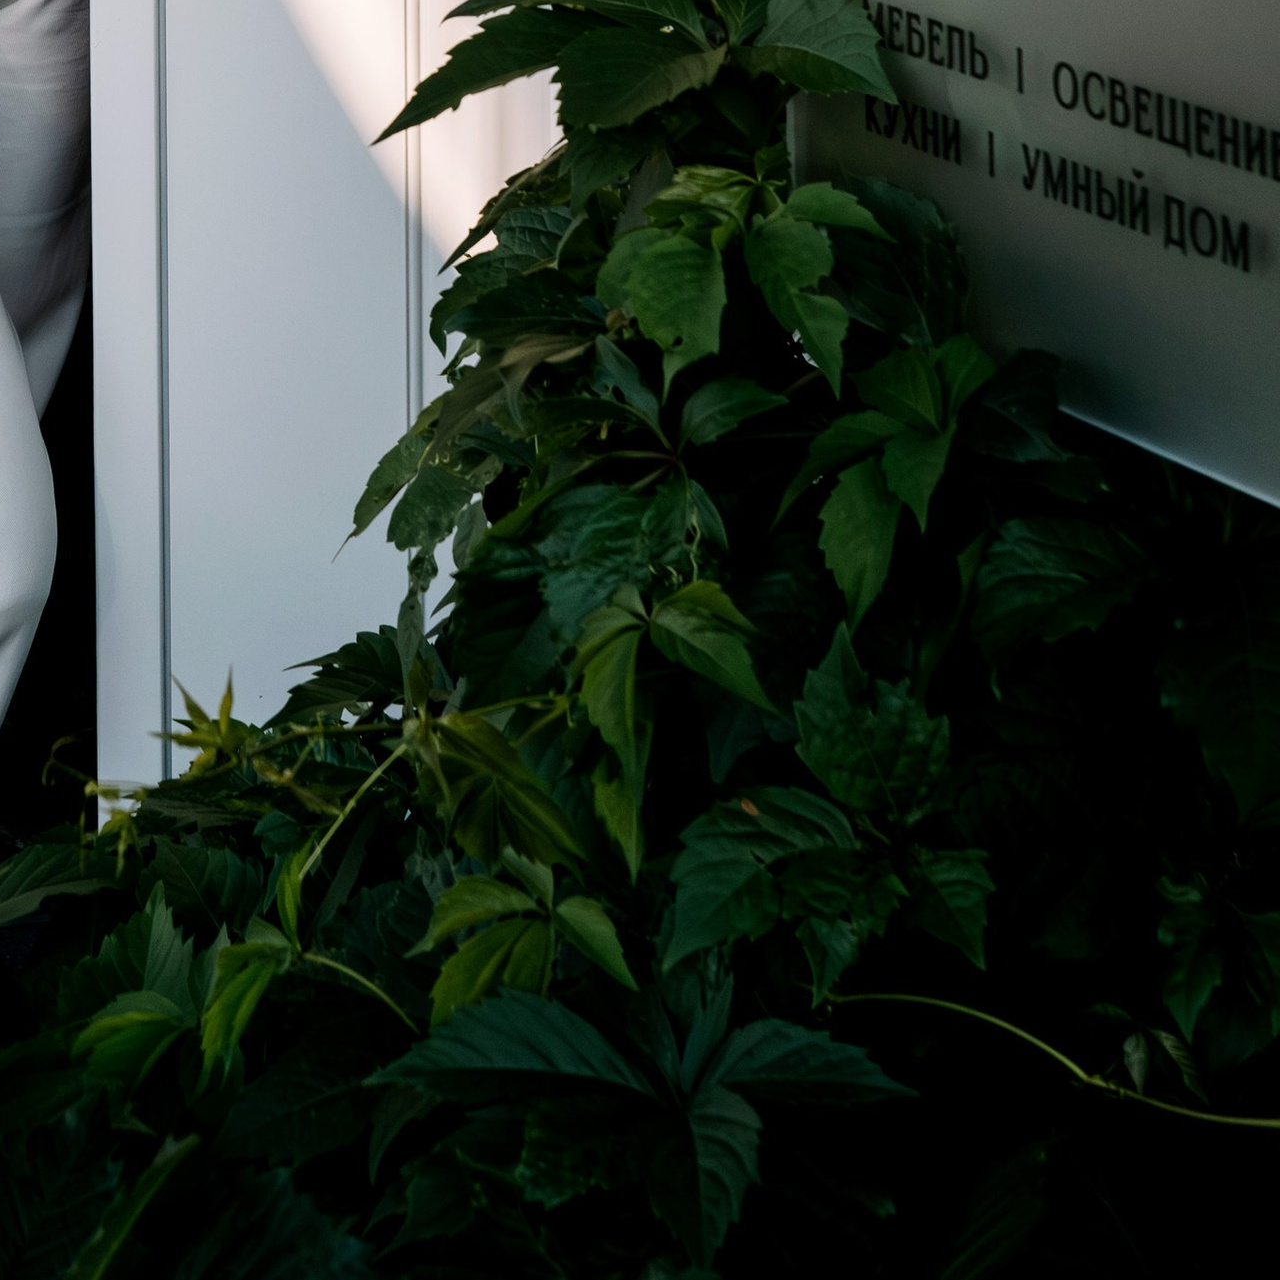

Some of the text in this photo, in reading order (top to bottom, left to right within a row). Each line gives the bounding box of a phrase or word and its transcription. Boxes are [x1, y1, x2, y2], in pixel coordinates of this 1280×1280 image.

[864, 97, 962, 166] КУХНИ
[1021, 142, 1150, 236] УМНЫЙ
[1163, 193, 1251, 273] ДОМ
